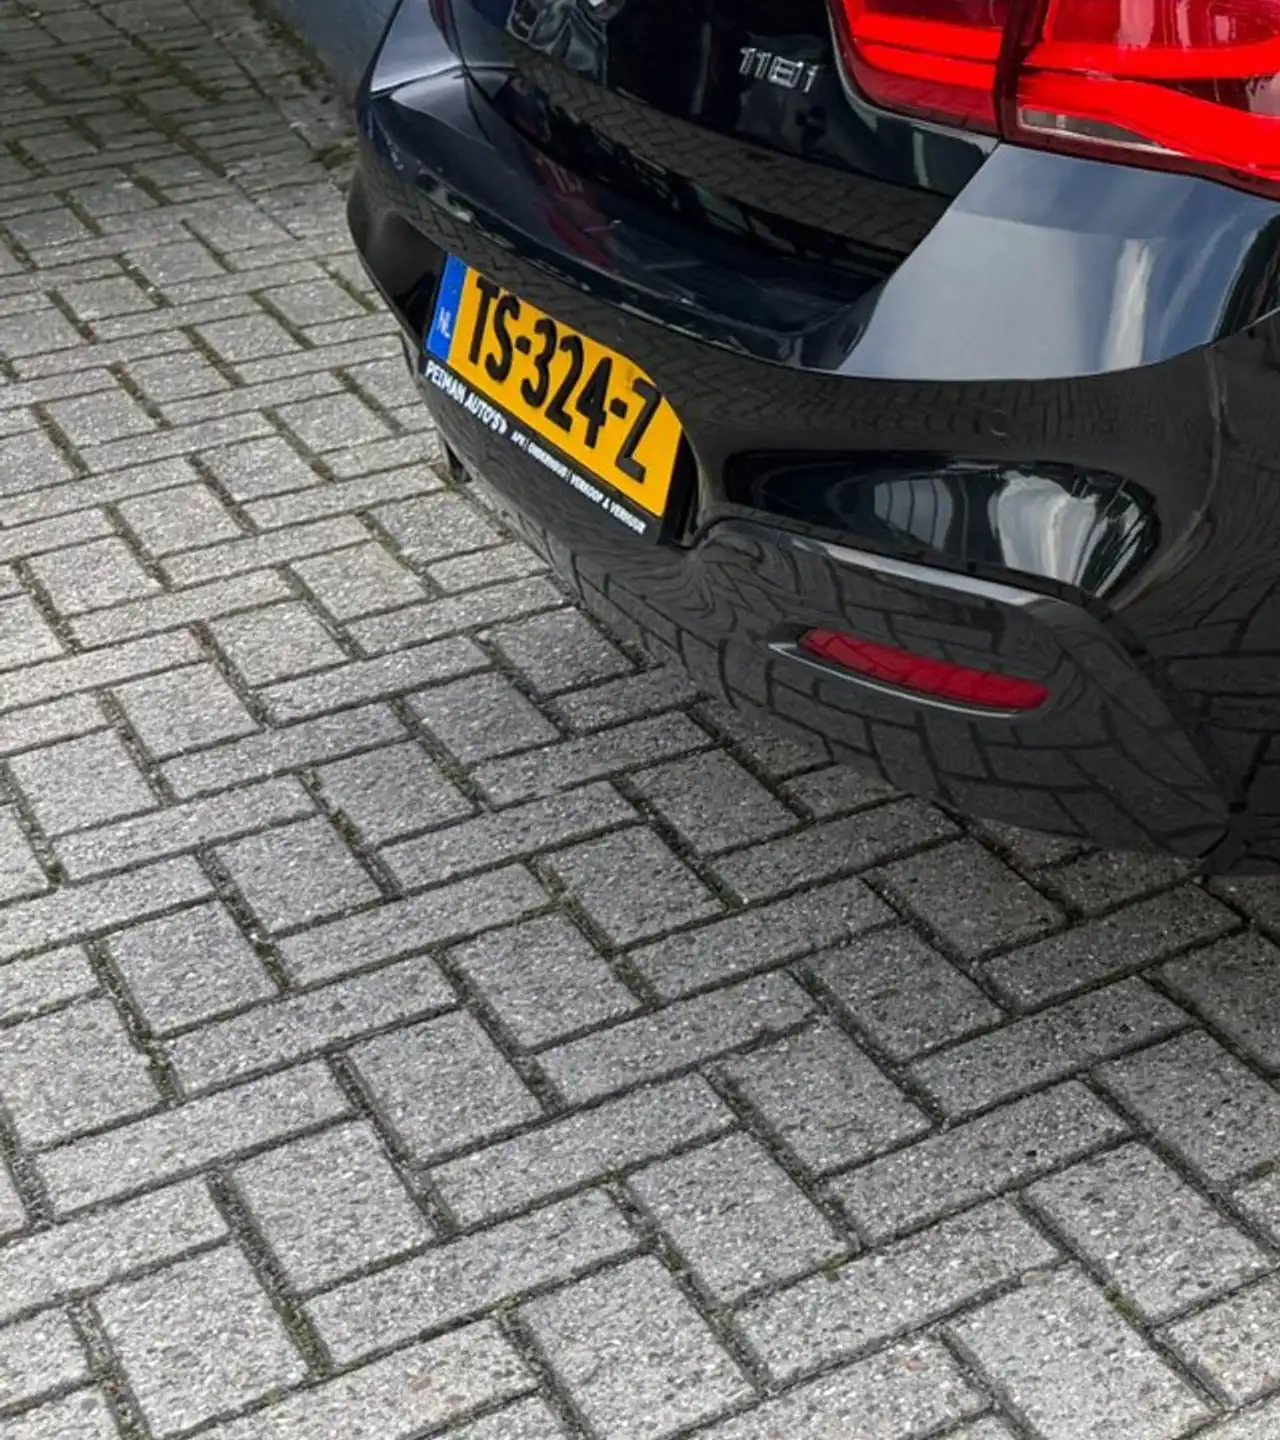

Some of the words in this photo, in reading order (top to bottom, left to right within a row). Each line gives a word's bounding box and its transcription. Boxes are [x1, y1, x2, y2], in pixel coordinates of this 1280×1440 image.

[739, 46, 819, 93] 118i
[468, 275, 662, 484] TS-324-Z
[464, 392, 501, 431] AUTO'S
